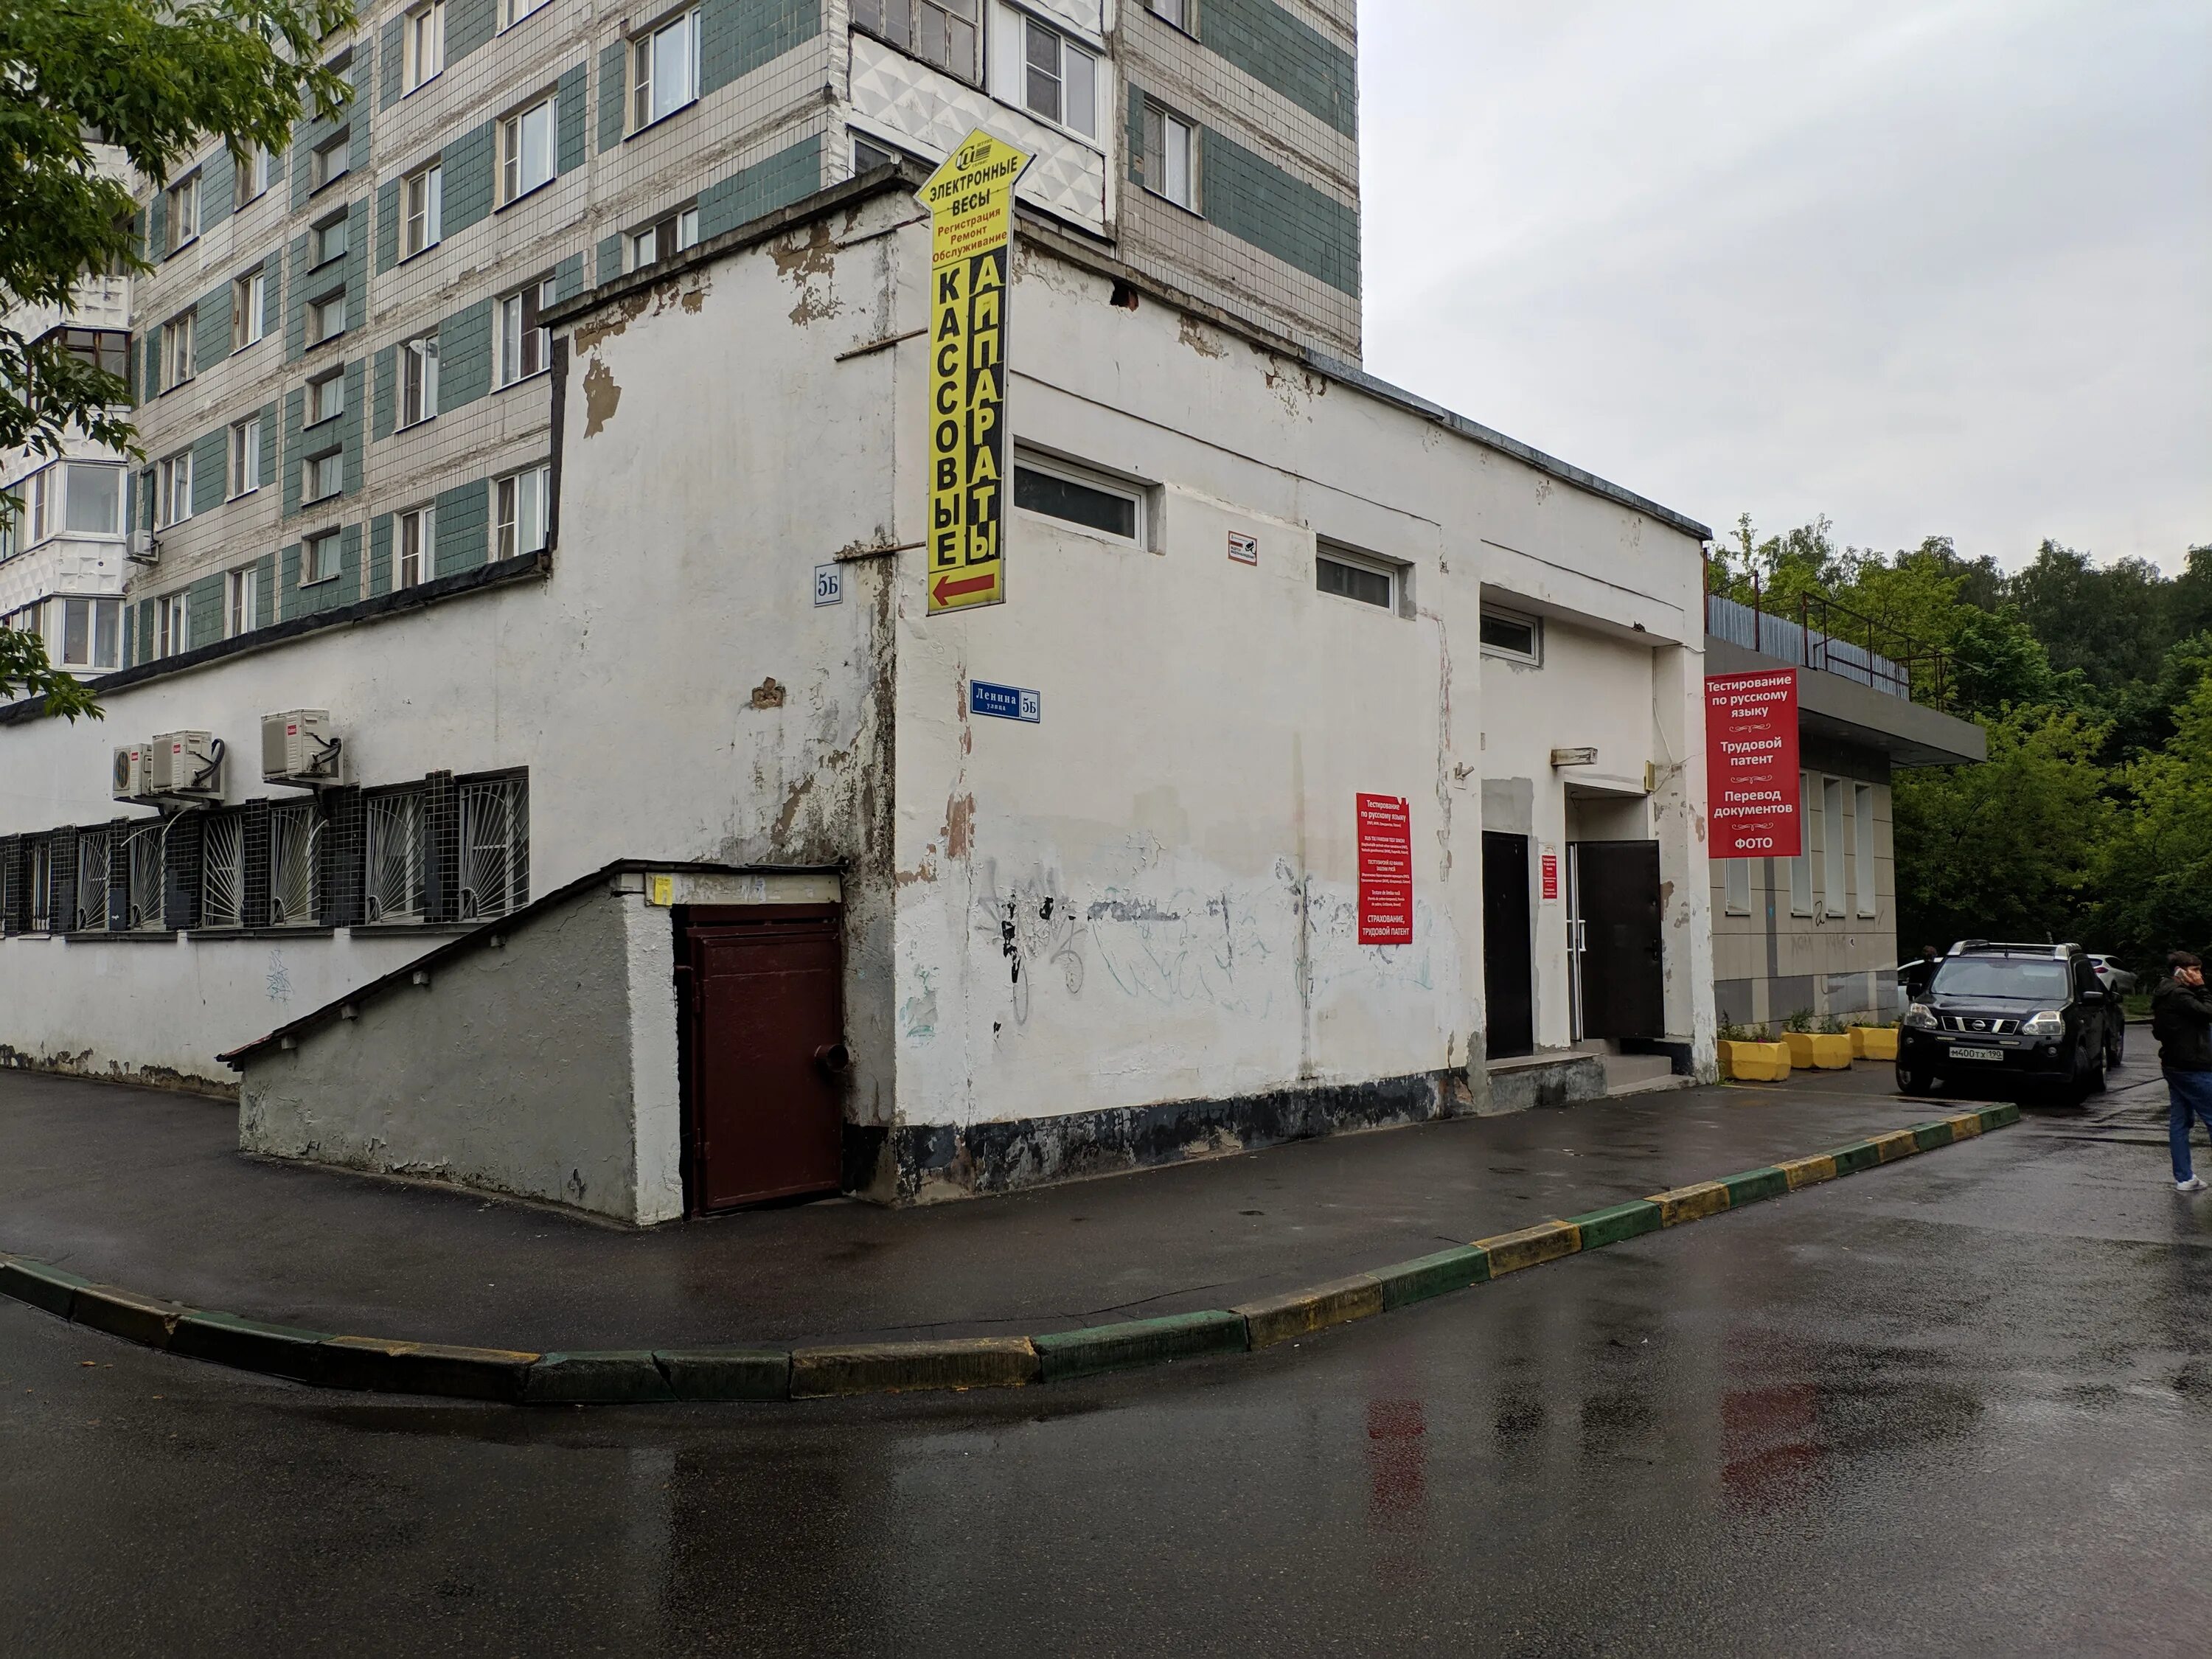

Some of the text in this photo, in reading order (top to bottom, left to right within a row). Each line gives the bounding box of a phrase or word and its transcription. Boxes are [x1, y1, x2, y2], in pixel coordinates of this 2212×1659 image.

[929, 156, 1018, 203] ЭЛЕКТРОННЫЕ
[952, 189, 990, 216] ВЕСЫ
[937, 208, 1001, 237] Регистрация
[950, 225, 987, 245] Ремонт
[932, 232, 1008, 262] Обслуживание
[970, 254, 1003, 560] АППАРАТЫ
[934, 267, 961, 566] КАССОВЫЕ
[818, 572, 838, 597] 5Б
[1706, 675, 1792, 692] Тестирование
[975, 687, 1017, 705] Ленина
[1712, 691, 1788, 706] по русскому
[987, 703, 1006, 712] улица
[1022, 697, 1037, 714] 5Б
[1731, 706, 1769, 718] языку
[1720, 736, 1782, 754] Трудовой
[1730, 755, 1774, 766] патент
[1366, 799, 1400, 810] Тестирование
[1724, 790, 1781, 803] Перевод
[1360, 810, 1406, 823] по русскому языку
[1714, 804, 1793, 818] документов
[1734, 837, 1773, 849] ФОТО
[1367, 914, 1405, 924] СТРАХОВАНИЕ,
[1362, 925, 1410, 937] ТРУДОВОЙ ПАТЕНТ
